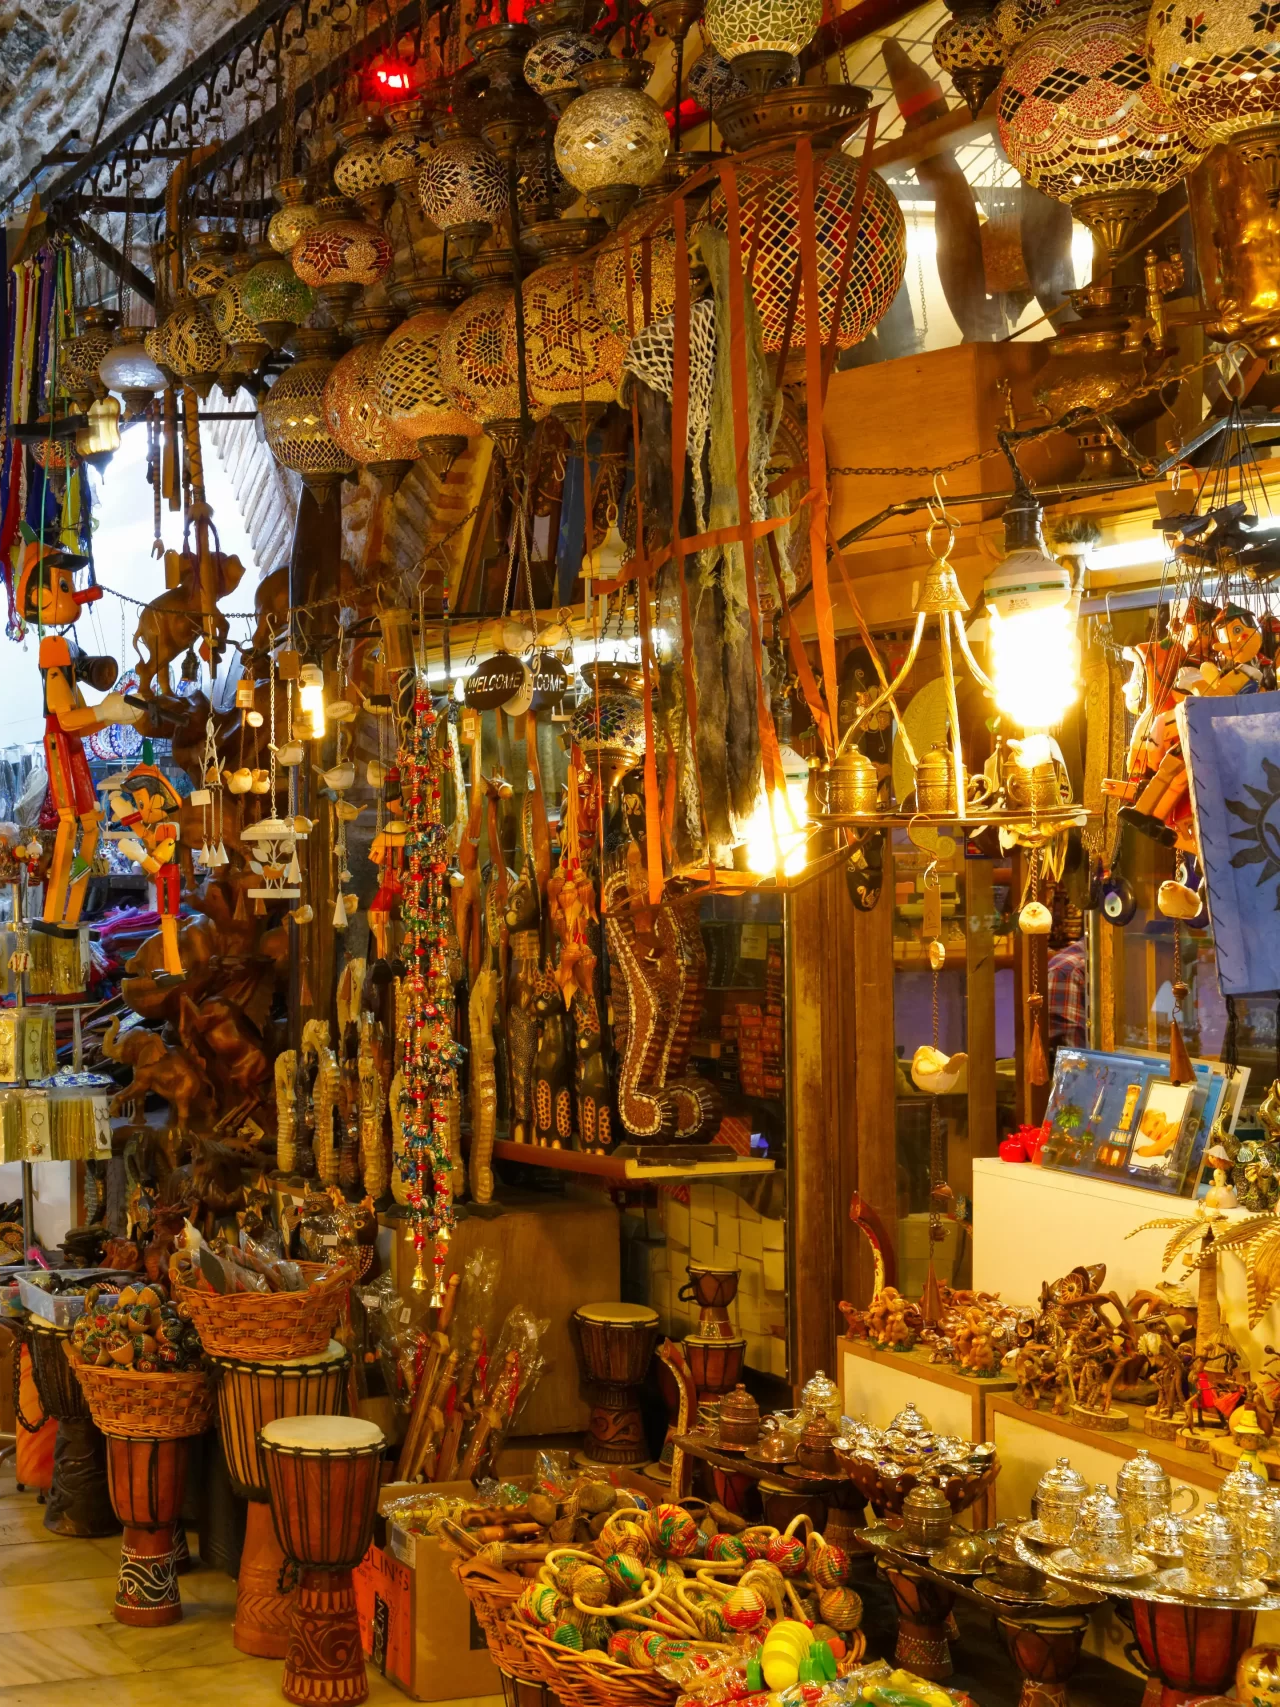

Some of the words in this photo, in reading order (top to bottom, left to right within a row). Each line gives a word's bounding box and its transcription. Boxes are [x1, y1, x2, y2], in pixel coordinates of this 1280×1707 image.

[468, 671, 522, 694] WELCOME
[530, 673, 565, 692] LCOME
[363, 1551, 409, 1591] LIN'S
[375, 1595, 385, 1665] COLIN'
